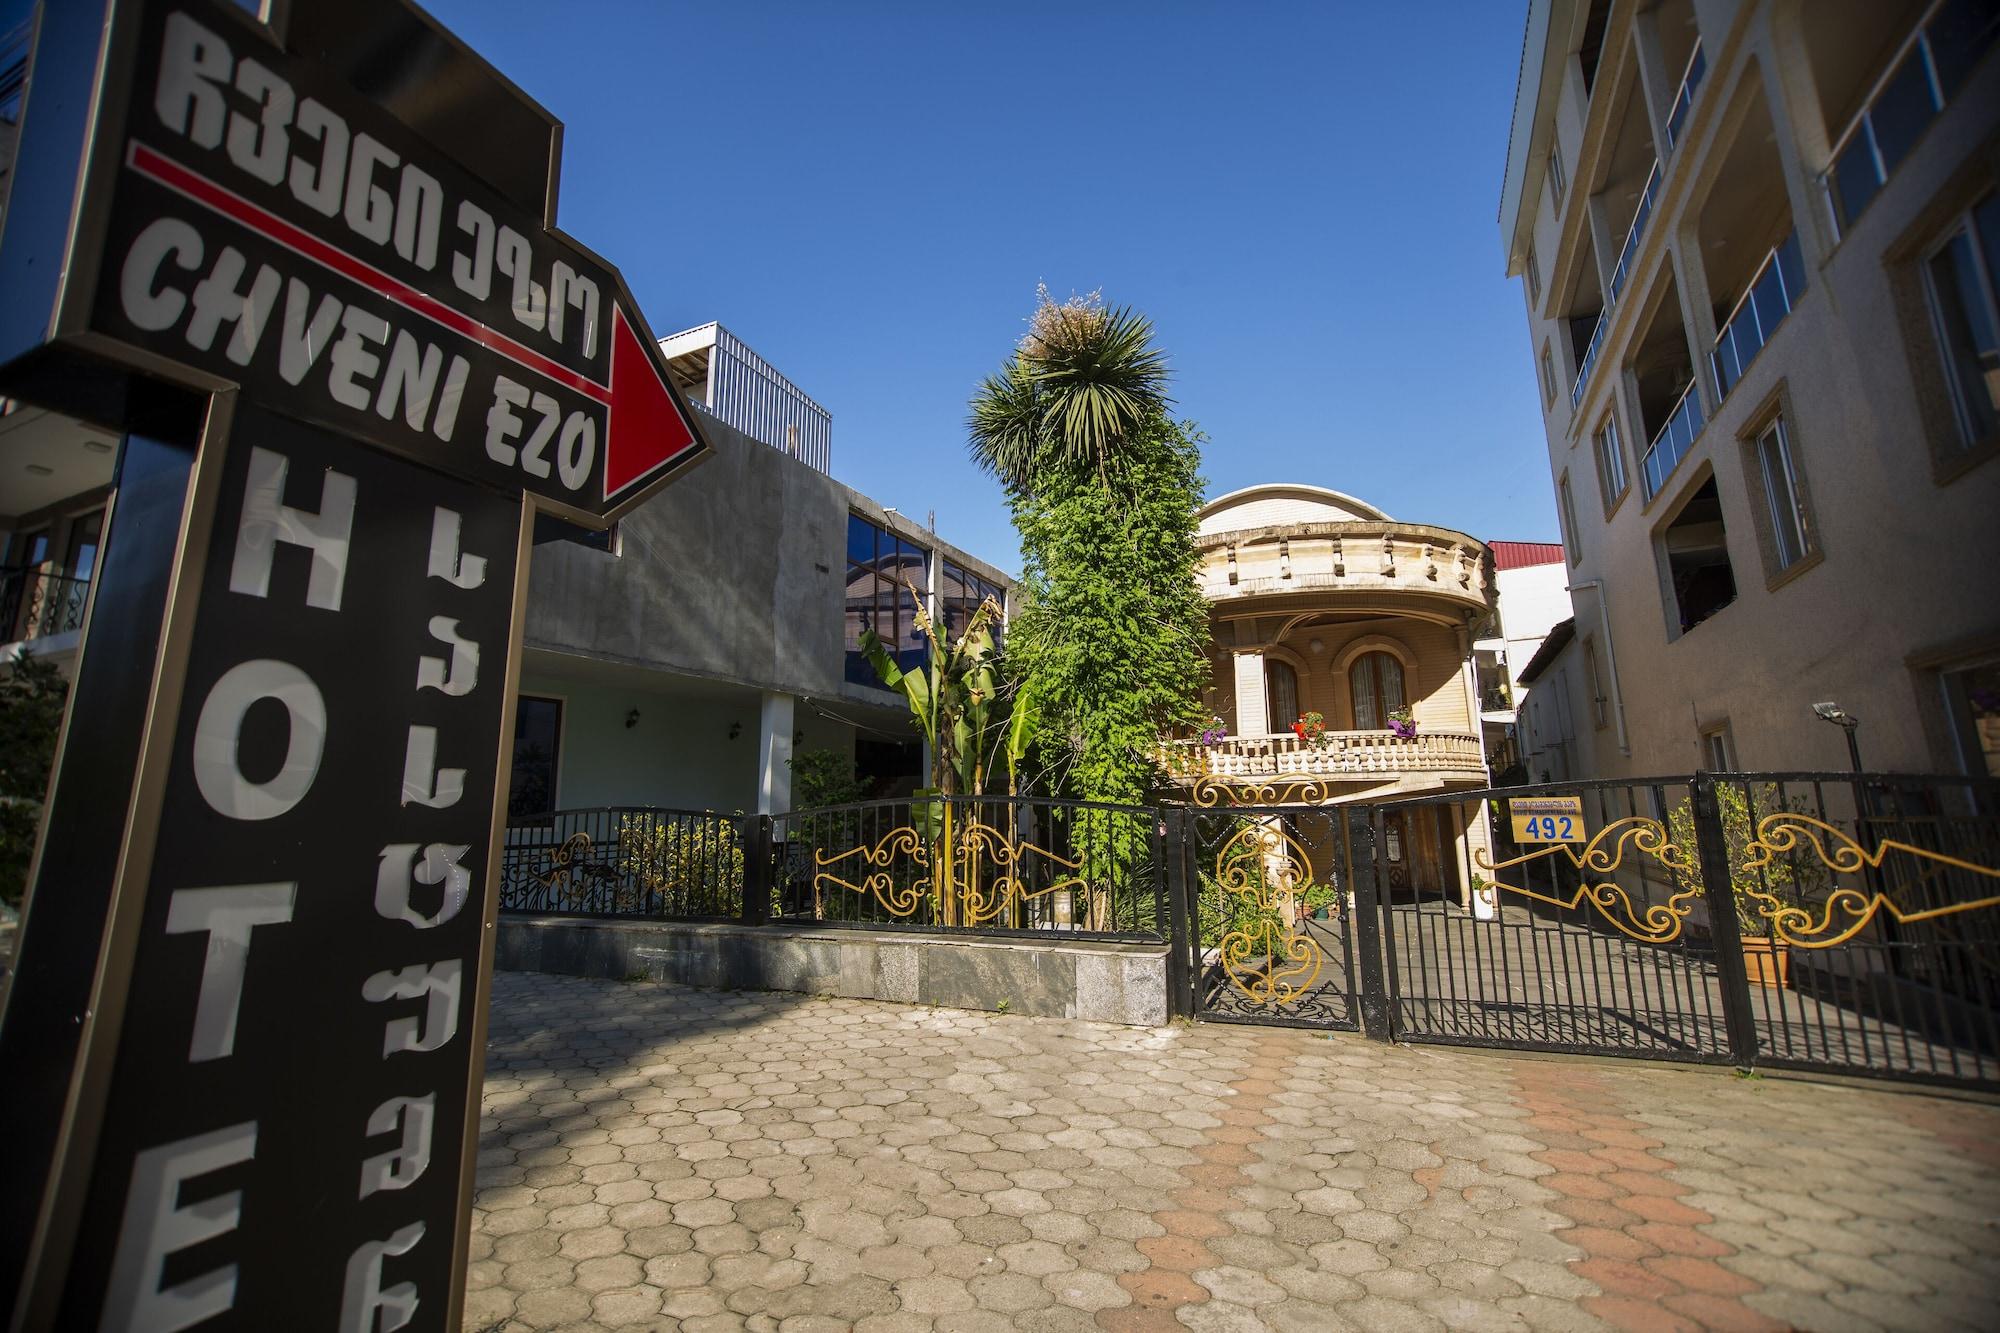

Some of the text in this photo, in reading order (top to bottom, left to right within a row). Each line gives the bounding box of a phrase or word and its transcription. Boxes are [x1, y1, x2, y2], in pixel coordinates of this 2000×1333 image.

[155, 10, 600, 361] ჩვენი ეზო
[121, 217, 596, 491] CHVENI EZO
[1525, 817, 1574, 839] 492
